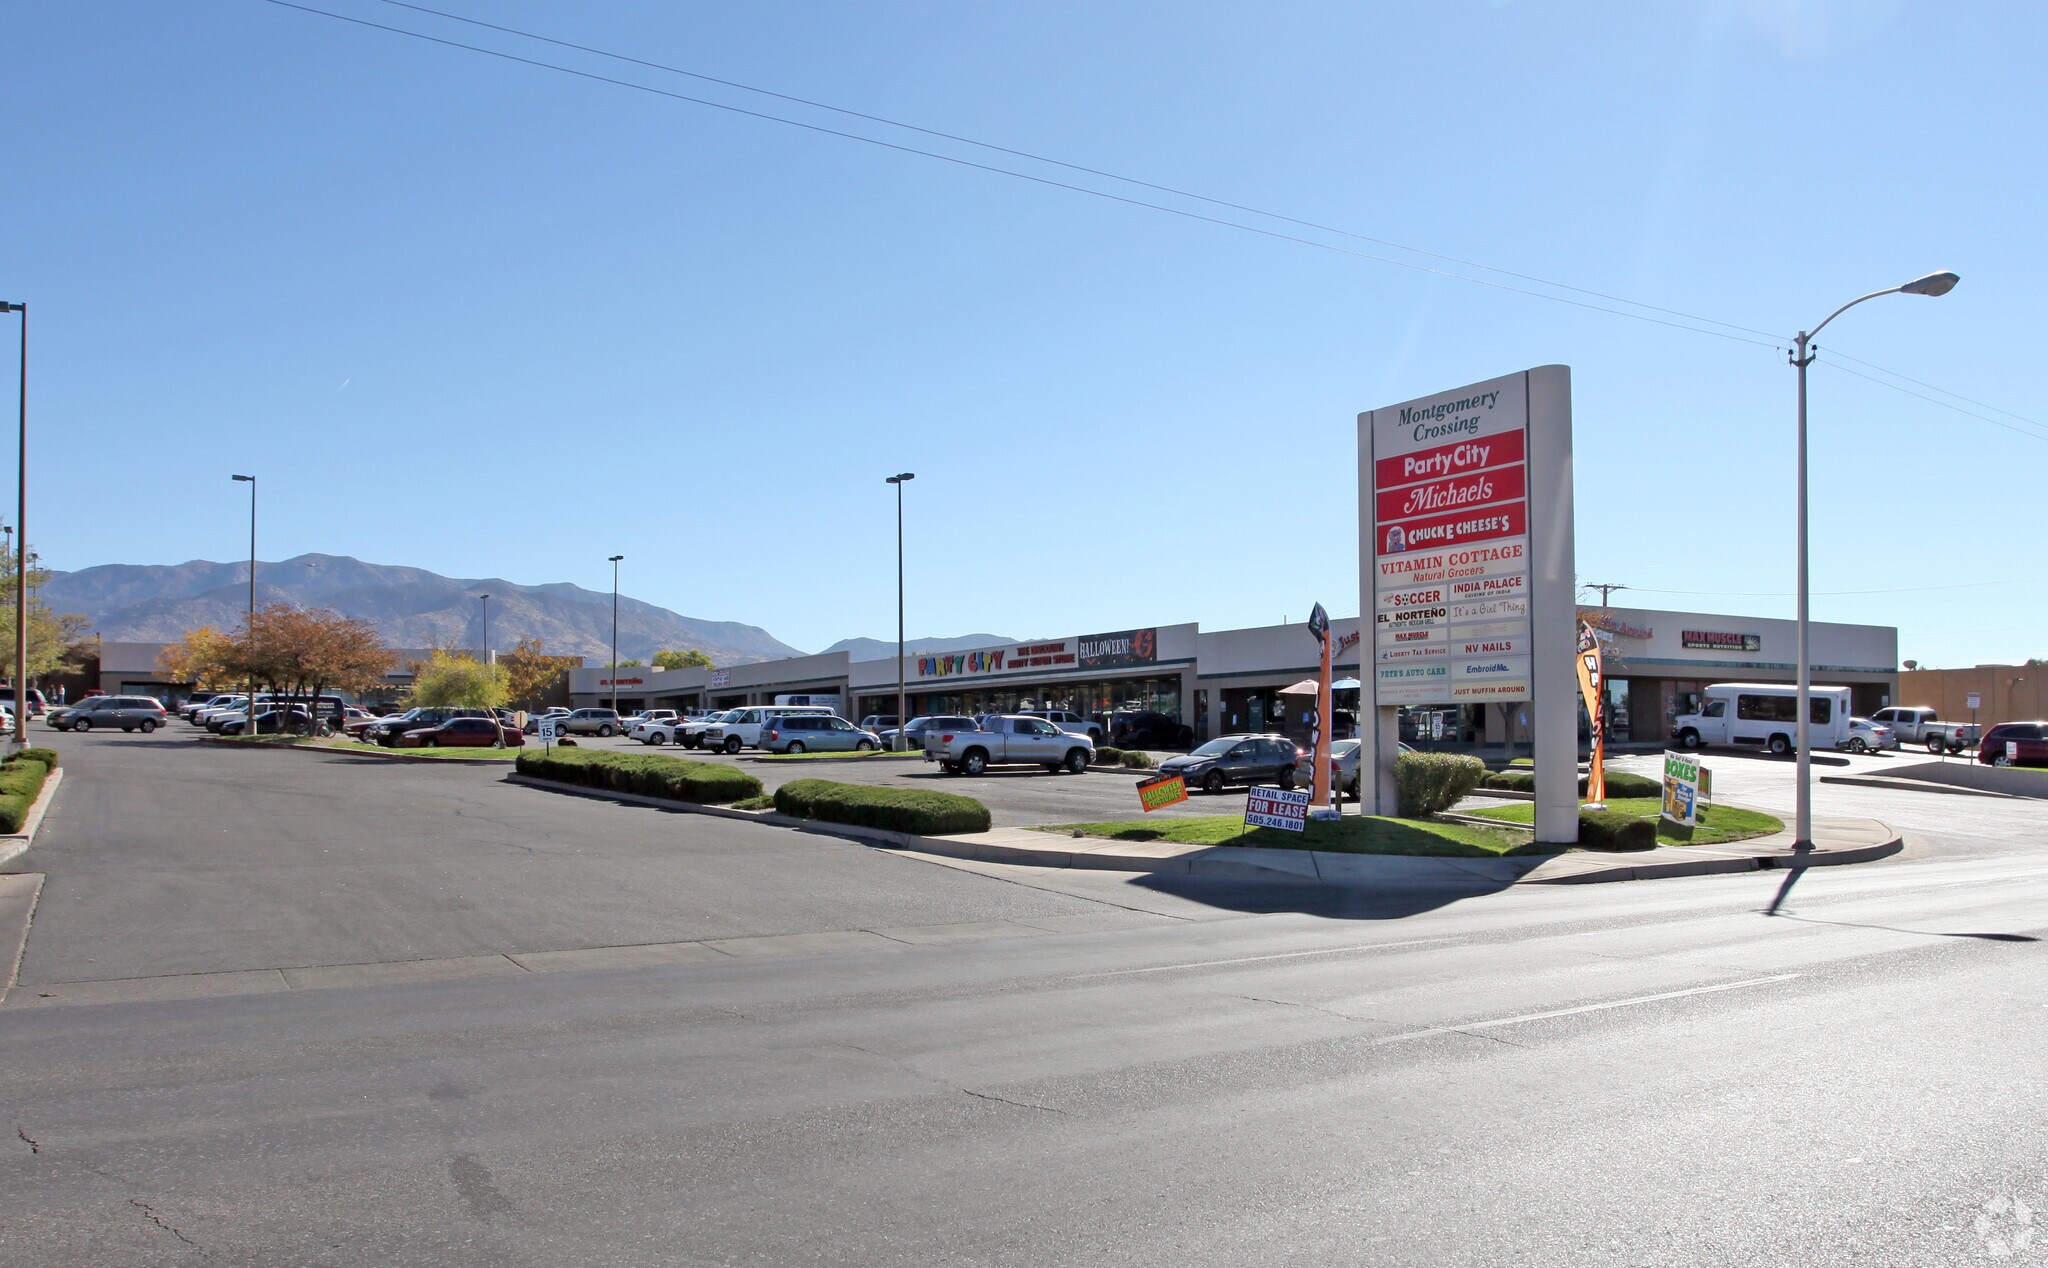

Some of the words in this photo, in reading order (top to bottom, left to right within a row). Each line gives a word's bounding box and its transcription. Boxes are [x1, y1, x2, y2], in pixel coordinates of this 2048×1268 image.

[1398, 391, 1500, 427] Montgomery
[1413, 415, 1481, 442] Crossing
[1403, 476, 1493, 514] Michaels
[1408, 526, 1445, 545] CHUCK
[1456, 515, 1510, 535] CHEESE'S
[1380, 555, 1443, 575] VITAMIN
[1448, 544, 1523, 566] COTTAGE
[1413, 569, 1445, 582] Natural
[1448, 566, 1485, 578] Grocers
[1454, 582, 1481, 593] INDIA
[1483, 577, 1522, 590] PALACE
[1377, 614, 1390, 623] EL
[1395, 607, 1446, 621] NORTEÑO
[1453, 606, 1469, 617] It's
[1479, 603, 1497, 614] Girl
[1499, 601, 1526, 615] Thing
[1338, 630, 1360, 649] Just
[1685, 631, 1705, 642] MAX
[1706, 632, 1743, 644] MUSCLE
[1080, 638, 1130, 659] HALLOWEEN!
[1465, 644, 1479, 653] NV
[1482, 641, 1512, 652] NAILS
[918, 655, 965, 676] PARTY
[968, 650, 1004, 673] CITY
[1380, 669, 1403, 678] PETE'S
[1405, 668, 1424, 677] AUTO
[1427, 667, 1446, 676] CARE
[1497, 685, 1525, 693] AROUND
[542, 727, 553, 737] 15
[1665, 758, 1697, 783] BOXES
[1251, 788, 1278, 800] RETAIL
[1281, 792, 1307, 804] SPACE
[1248, 798, 1269, 813] FOR
[1272, 802, 1306, 819] LEASE
[1247, 814, 1303, 831] 505.246.1801
